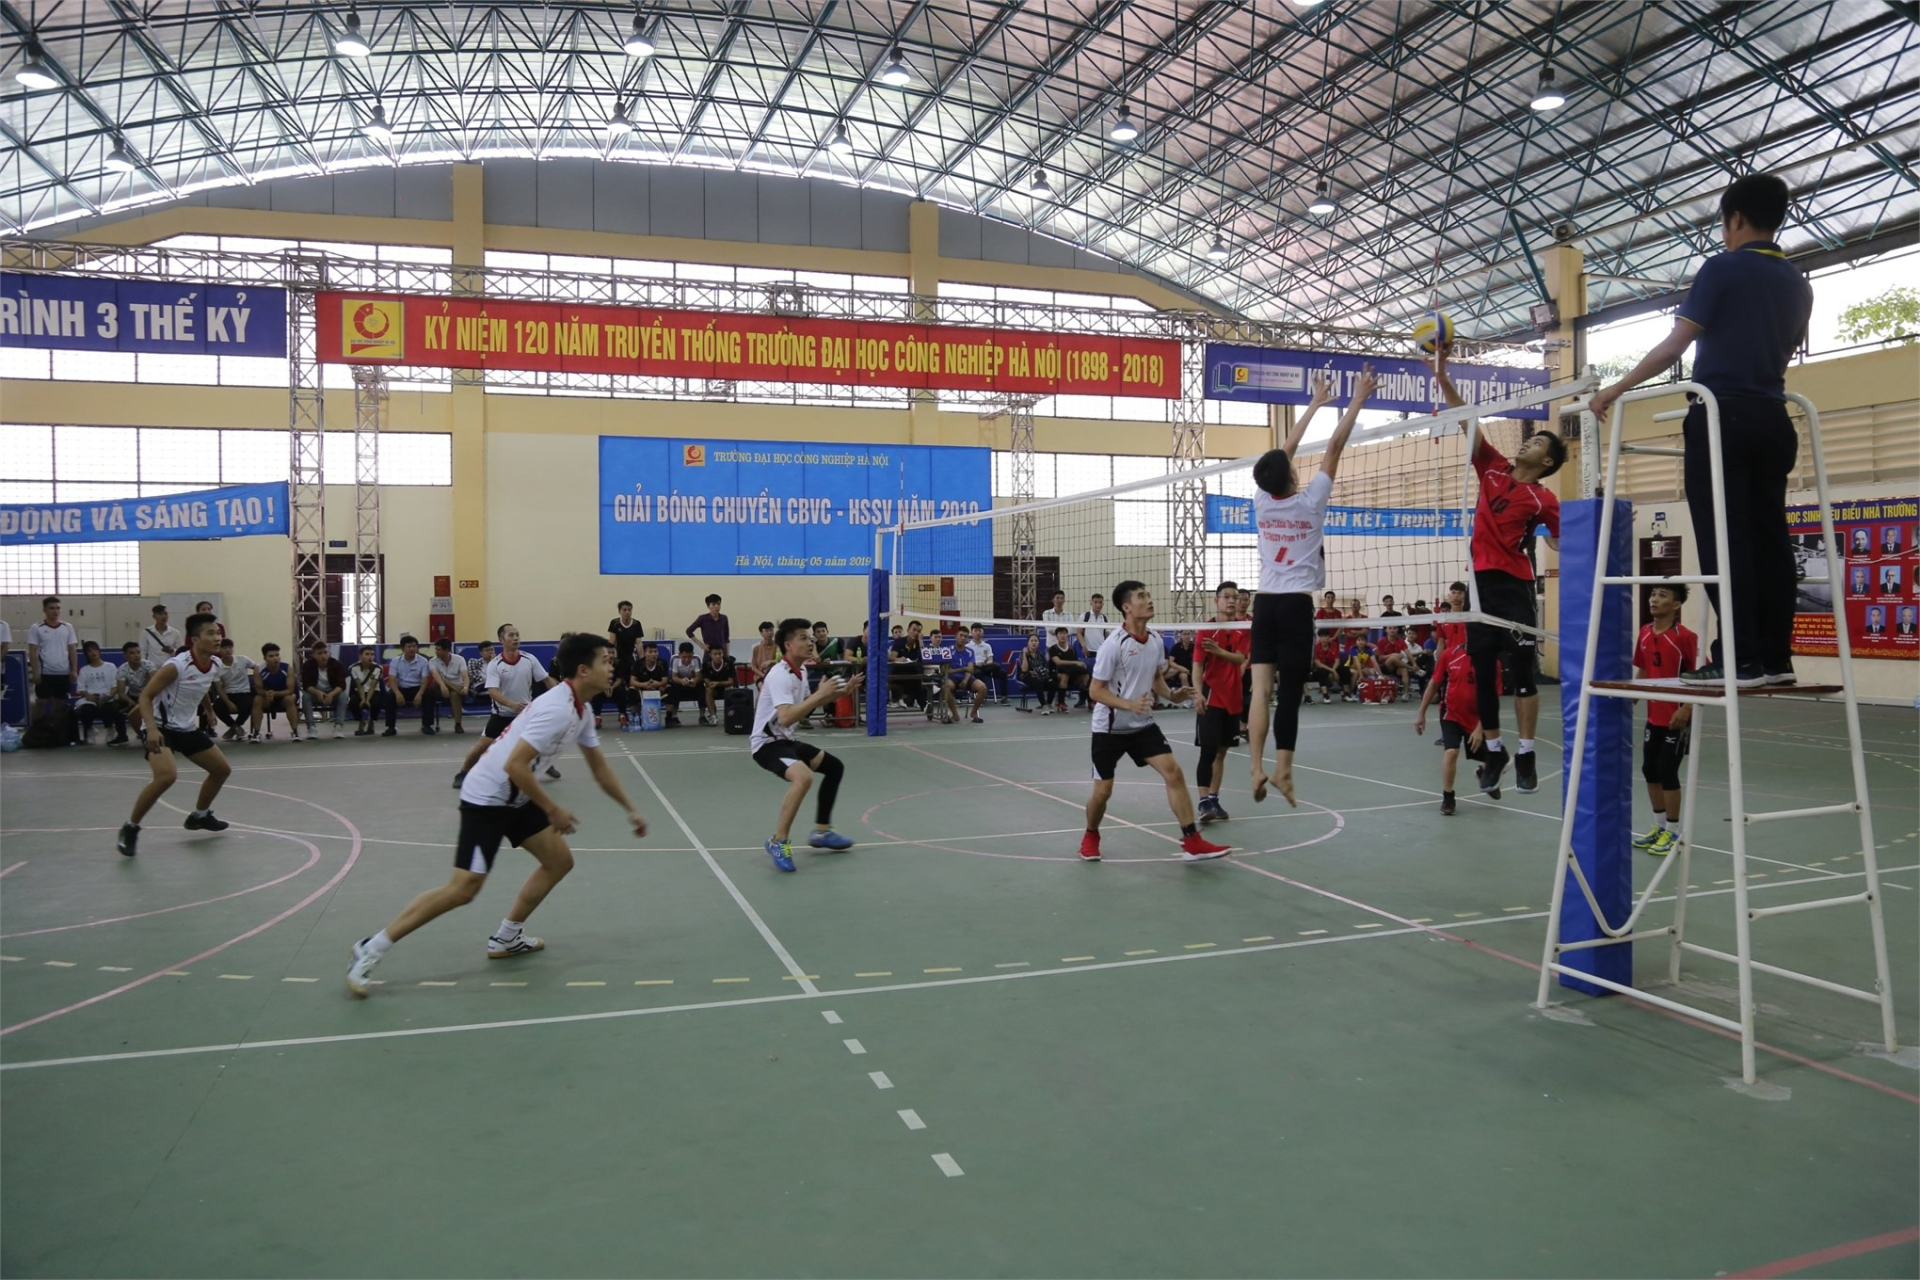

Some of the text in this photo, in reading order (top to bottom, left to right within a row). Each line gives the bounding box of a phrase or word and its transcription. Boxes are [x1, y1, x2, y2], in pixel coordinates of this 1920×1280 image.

[97, 302, 119, 339] 3
[130, 292, 197, 342] THẾ
[207, 292, 251, 343] KỶ
[425, 300, 450, 350] KỶ
[456, 310, 507, 359] NIỆM
[514, 321, 549, 355] 120
[555, 315, 599, 357] NĂM
[604, 316, 676, 361] TRUYỀN
[681, 317, 742, 364] THỐNG
[746, 326, 816, 367] TRƯỜNG
[821, 338, 850, 376] ĐẠI
[855, 338, 889, 377] HỌC
[895, 334, 939, 374] CÔNG
[944, 338, 1004, 384] NGHIỆP
[1008, 341, 1029, 378] HÀ
[1034, 341, 1061, 386] NỘI
[1066, 350, 1109, 382] (1898
[1122, 354, 1164, 387] 2018)
[1376, 367, 1425, 403] NHỮNG
[1480, 371, 1506, 406] BỀN
[713, 449, 889, 469] TRƯỜNG ĐẠI HỌC CÔNG NGHIỆP HÀ NỘI
[614, 483, 651, 523] GIẢI
[657, 488, 706, 524] BÓNG
[712, 487, 782, 524] CHUYỀN
[787, 497, 831, 525] CBVC
[848, 498, 892, 526] HSSV
[897, 493, 935, 523] NĂM
[1785, 511, 1801, 527] HỌC
[1802, 510, 1822, 524] SINH
[1842, 502, 1860, 521] BIỂU
[1863, 506, 1881, 519] NHÀ
[1883, 500, 1918, 518] TRƯỜNG
[0, 507, 82, 540] ĐỘNG
[91, 503, 128, 531] VÀ
[135, 499, 208, 530] SÁNG
[1391, 512, 1446, 529] TRUNG
[734, 554, 872, 569] Hà Nội, tháng 05 năm 2019
[922, 649, 931, 659] 6
[942, 649, 951, 659] 2
[1644, 729, 1651, 742] 3
